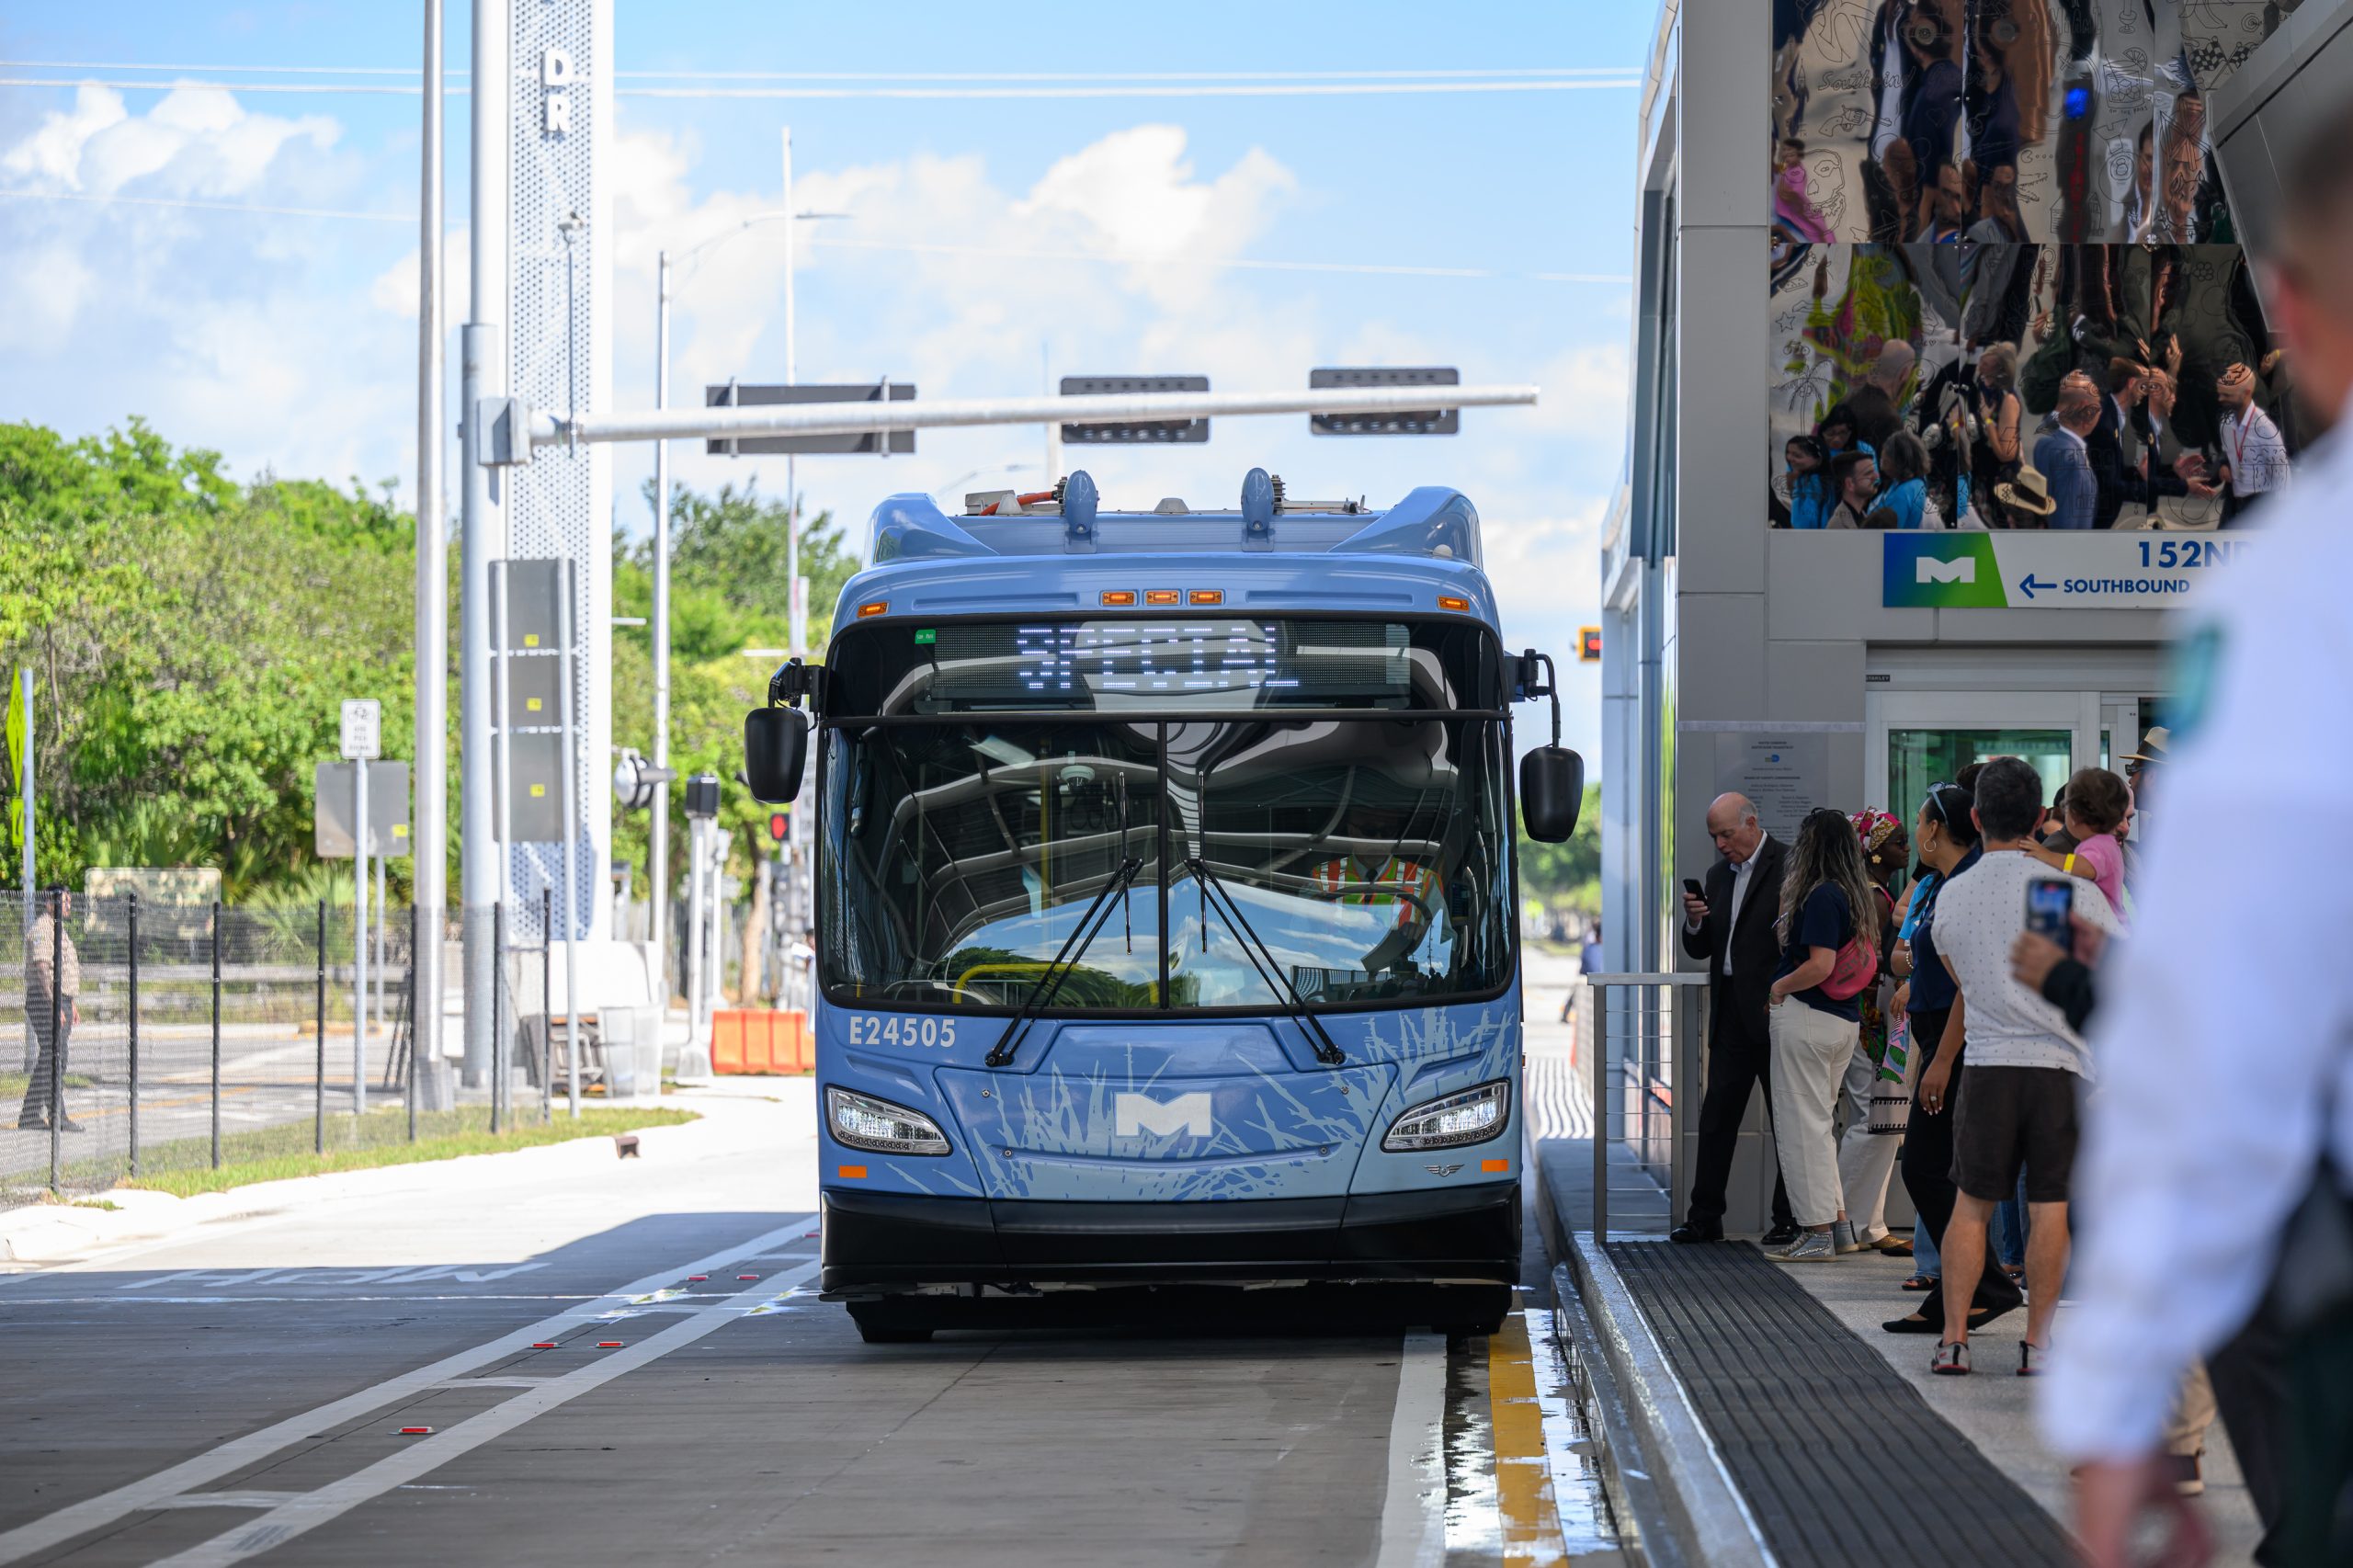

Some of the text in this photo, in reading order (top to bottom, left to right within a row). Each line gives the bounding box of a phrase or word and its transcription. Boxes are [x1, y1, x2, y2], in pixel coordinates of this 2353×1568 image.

[2063, 579, 2190, 594] SOUTHBOUND
[1017, 627, 1299, 688] SPECIAL
[850, 1017, 956, 1048] E24505
